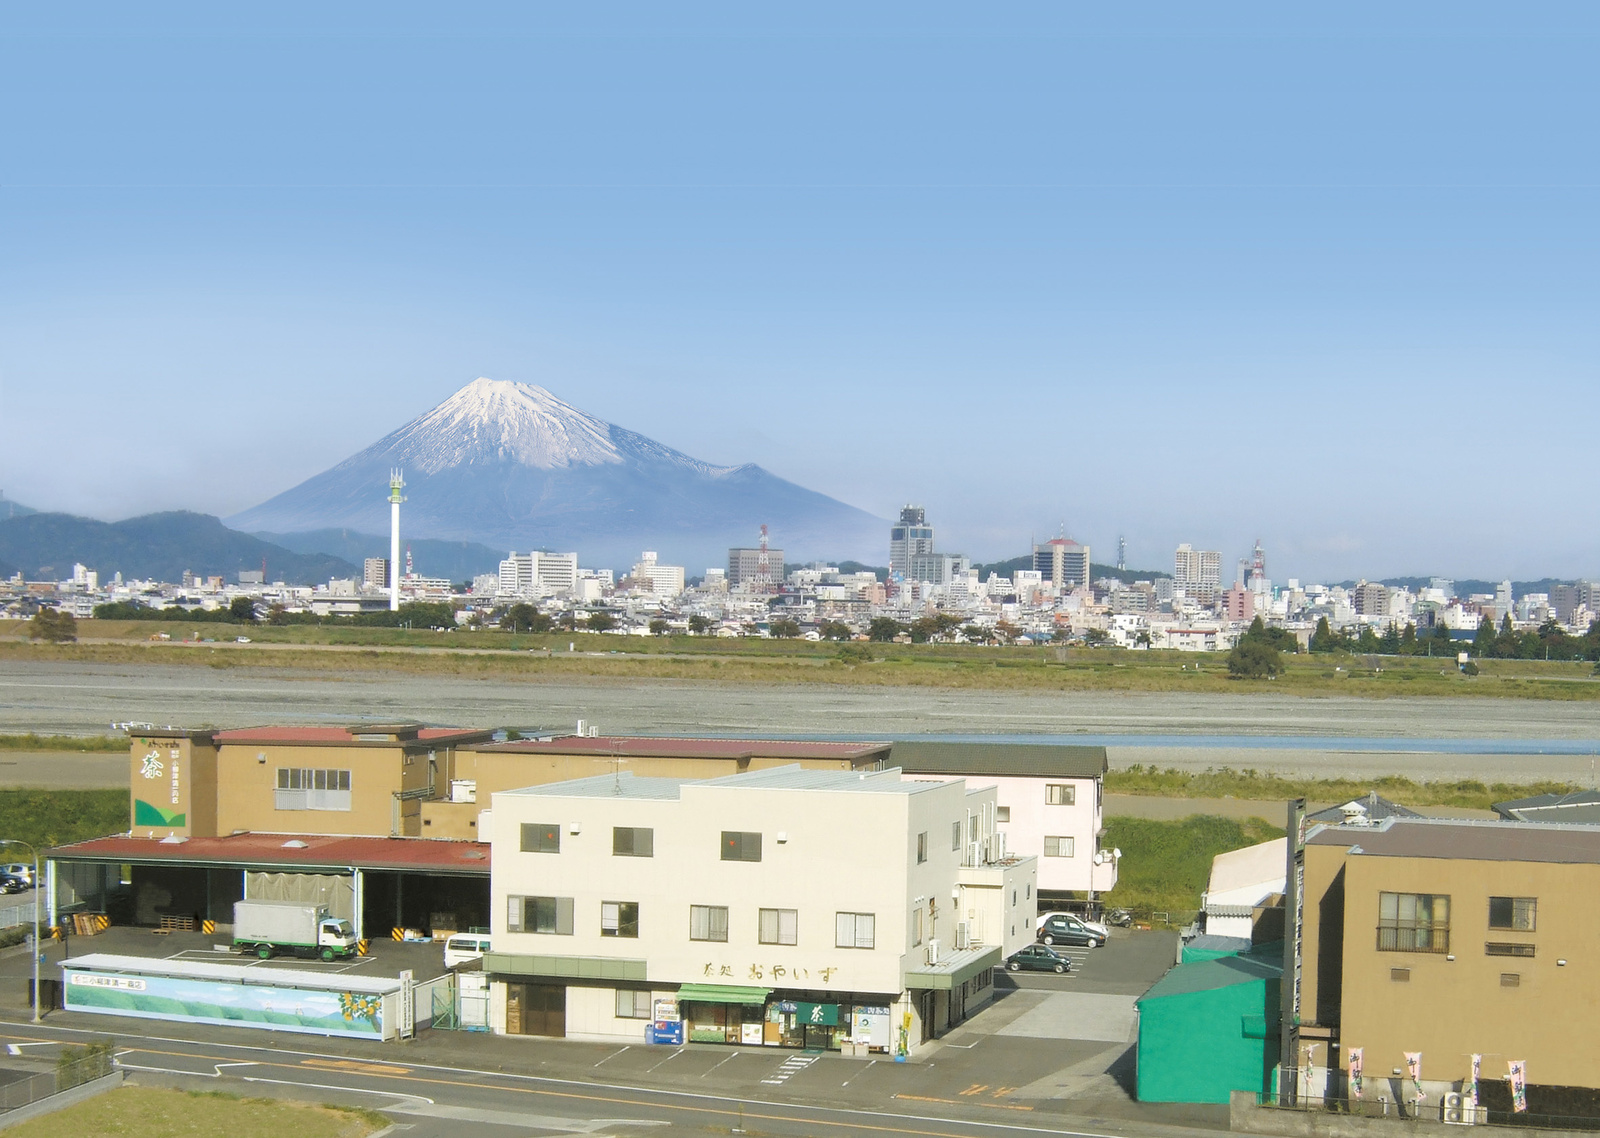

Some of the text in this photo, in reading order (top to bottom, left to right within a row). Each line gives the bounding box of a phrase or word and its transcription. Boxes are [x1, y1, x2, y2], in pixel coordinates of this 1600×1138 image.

[140, 750, 164, 779] 茶
[703, 962, 838, 984] 茶処 おやいず
[810, 1004, 824, 1023] 茶
